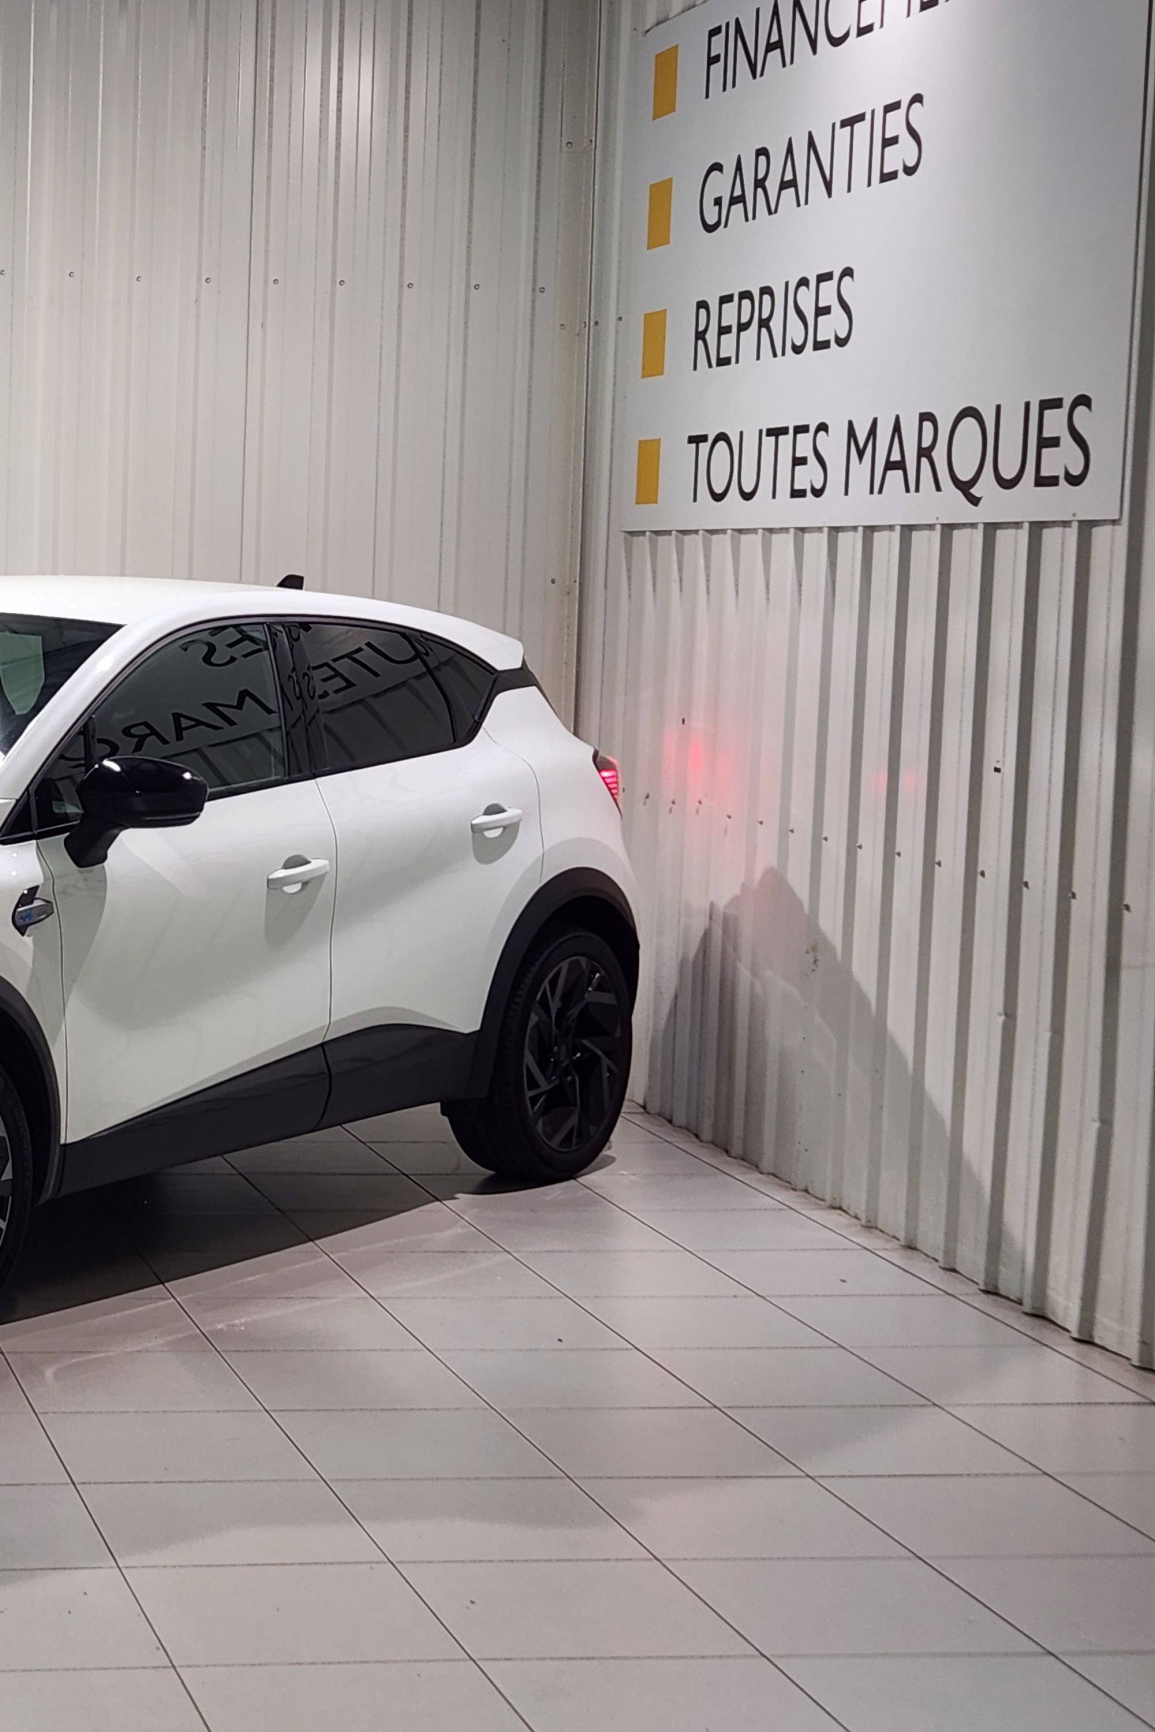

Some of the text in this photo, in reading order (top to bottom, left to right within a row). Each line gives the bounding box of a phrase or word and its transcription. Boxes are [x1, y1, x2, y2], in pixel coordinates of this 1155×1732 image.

[704, 0, 948, 100] FINANCE
[699, 92, 924, 233] GARANTIES
[692, 266, 855, 371] REPRISES
[687, 393, 1093, 508] TOUTES MARQUES
